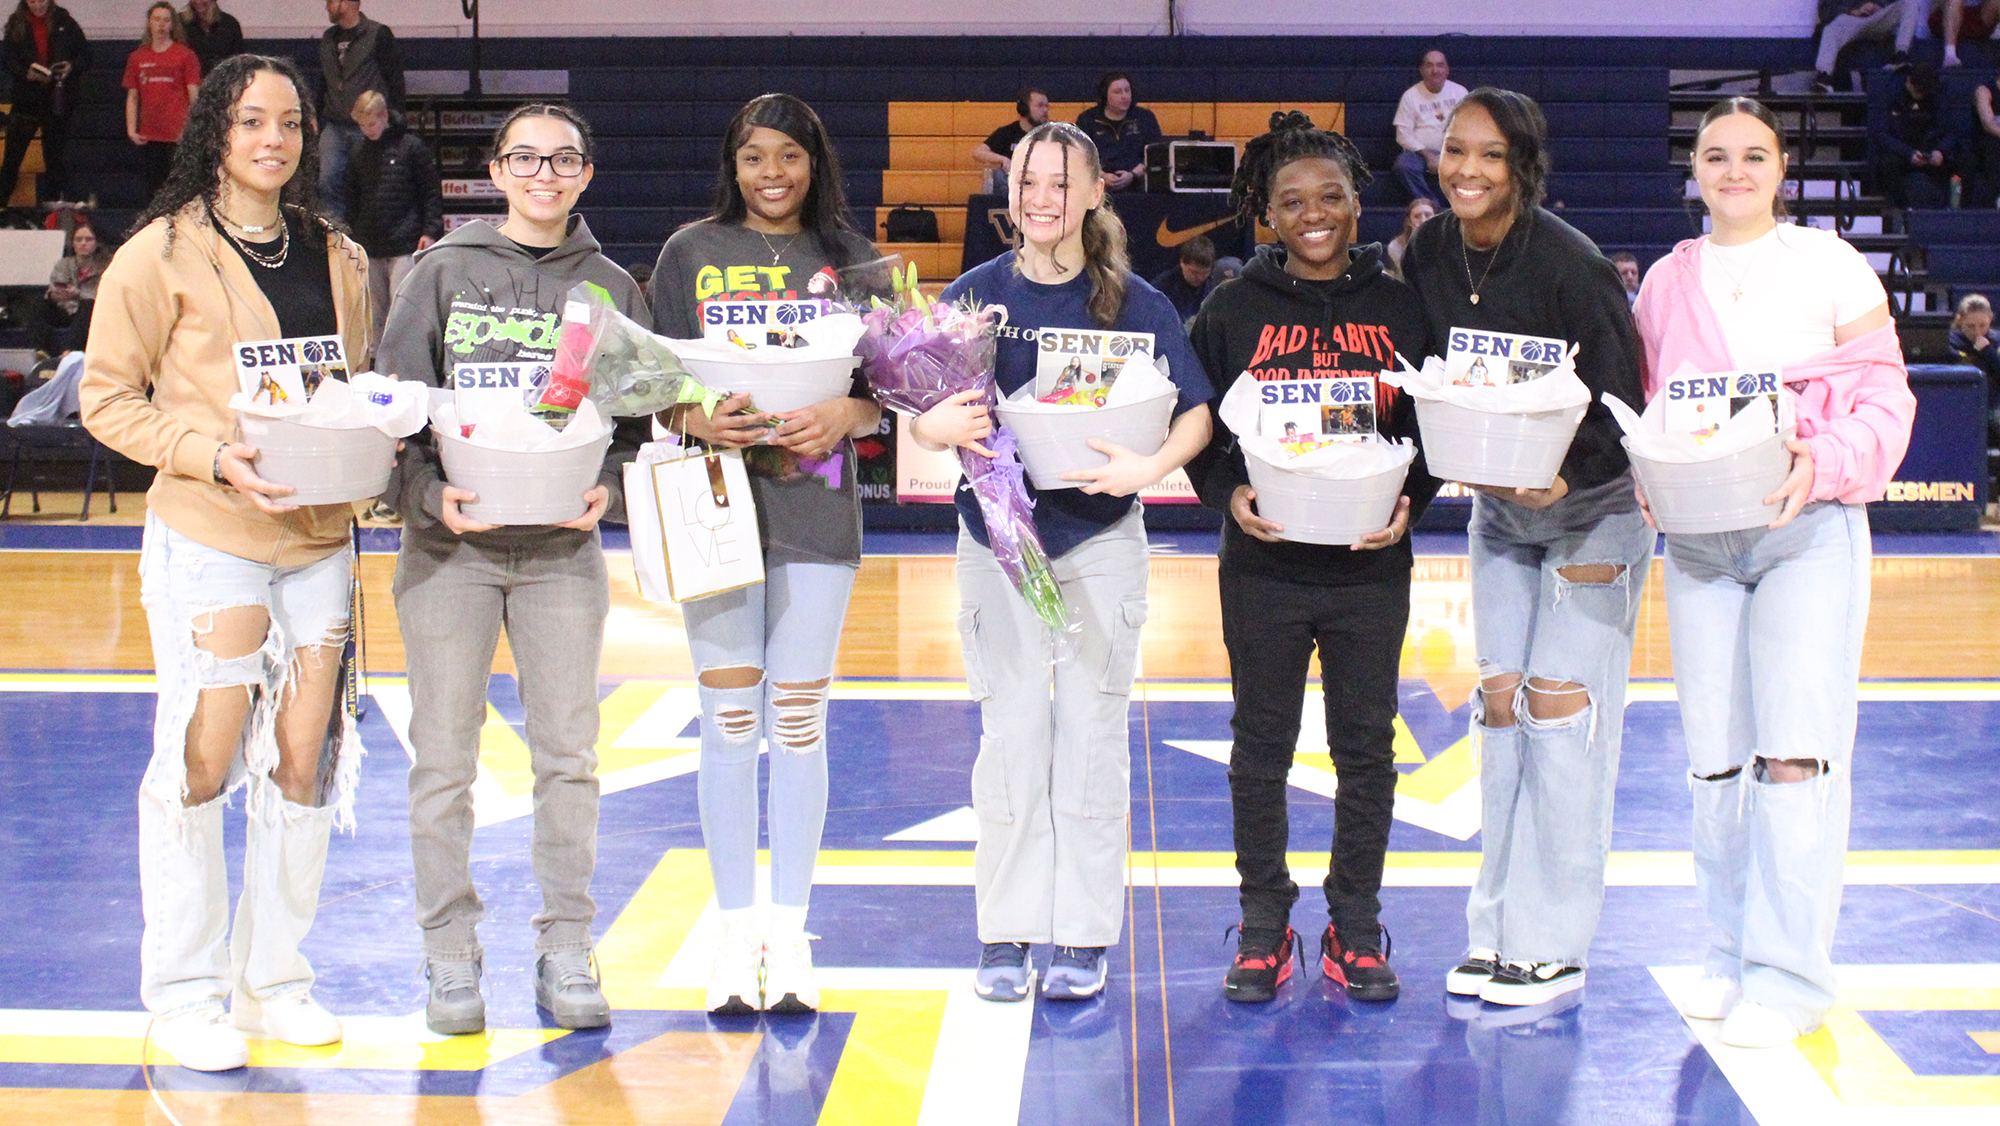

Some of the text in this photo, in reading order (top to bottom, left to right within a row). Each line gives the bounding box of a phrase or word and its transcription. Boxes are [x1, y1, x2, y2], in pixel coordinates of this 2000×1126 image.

[696, 265, 792, 300] GET
[1248, 324, 1308, 369] BAD
[1313, 352, 1341, 367] BUT
[909, 478, 951, 491] Proud
[1146, 480, 1191, 491] hlete
[1881, 481, 1975, 502] ESMEN
[347, 657, 356, 702] WILLIAM
